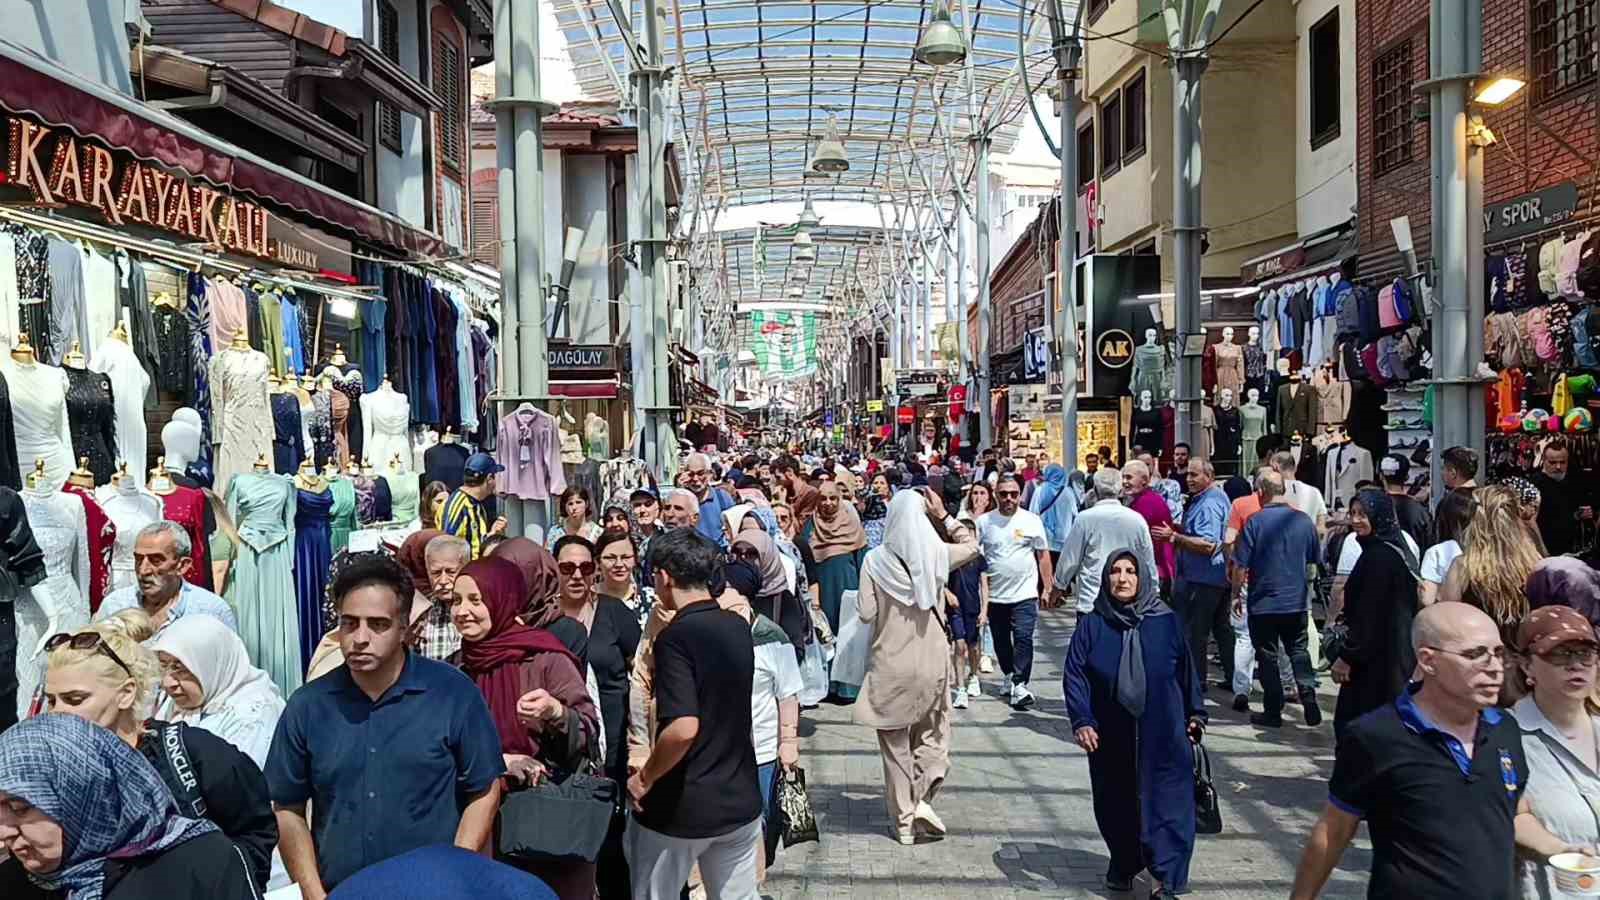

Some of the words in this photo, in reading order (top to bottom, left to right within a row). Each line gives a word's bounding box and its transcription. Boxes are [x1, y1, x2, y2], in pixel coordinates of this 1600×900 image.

[10, 118, 270, 256] KARAYAKALI
[1502, 198, 1541, 227] SPOR
[277, 240, 318, 268] LUXURY
[1102, 341, 1129, 357] AK
[165, 725, 197, 793] MONCLER
